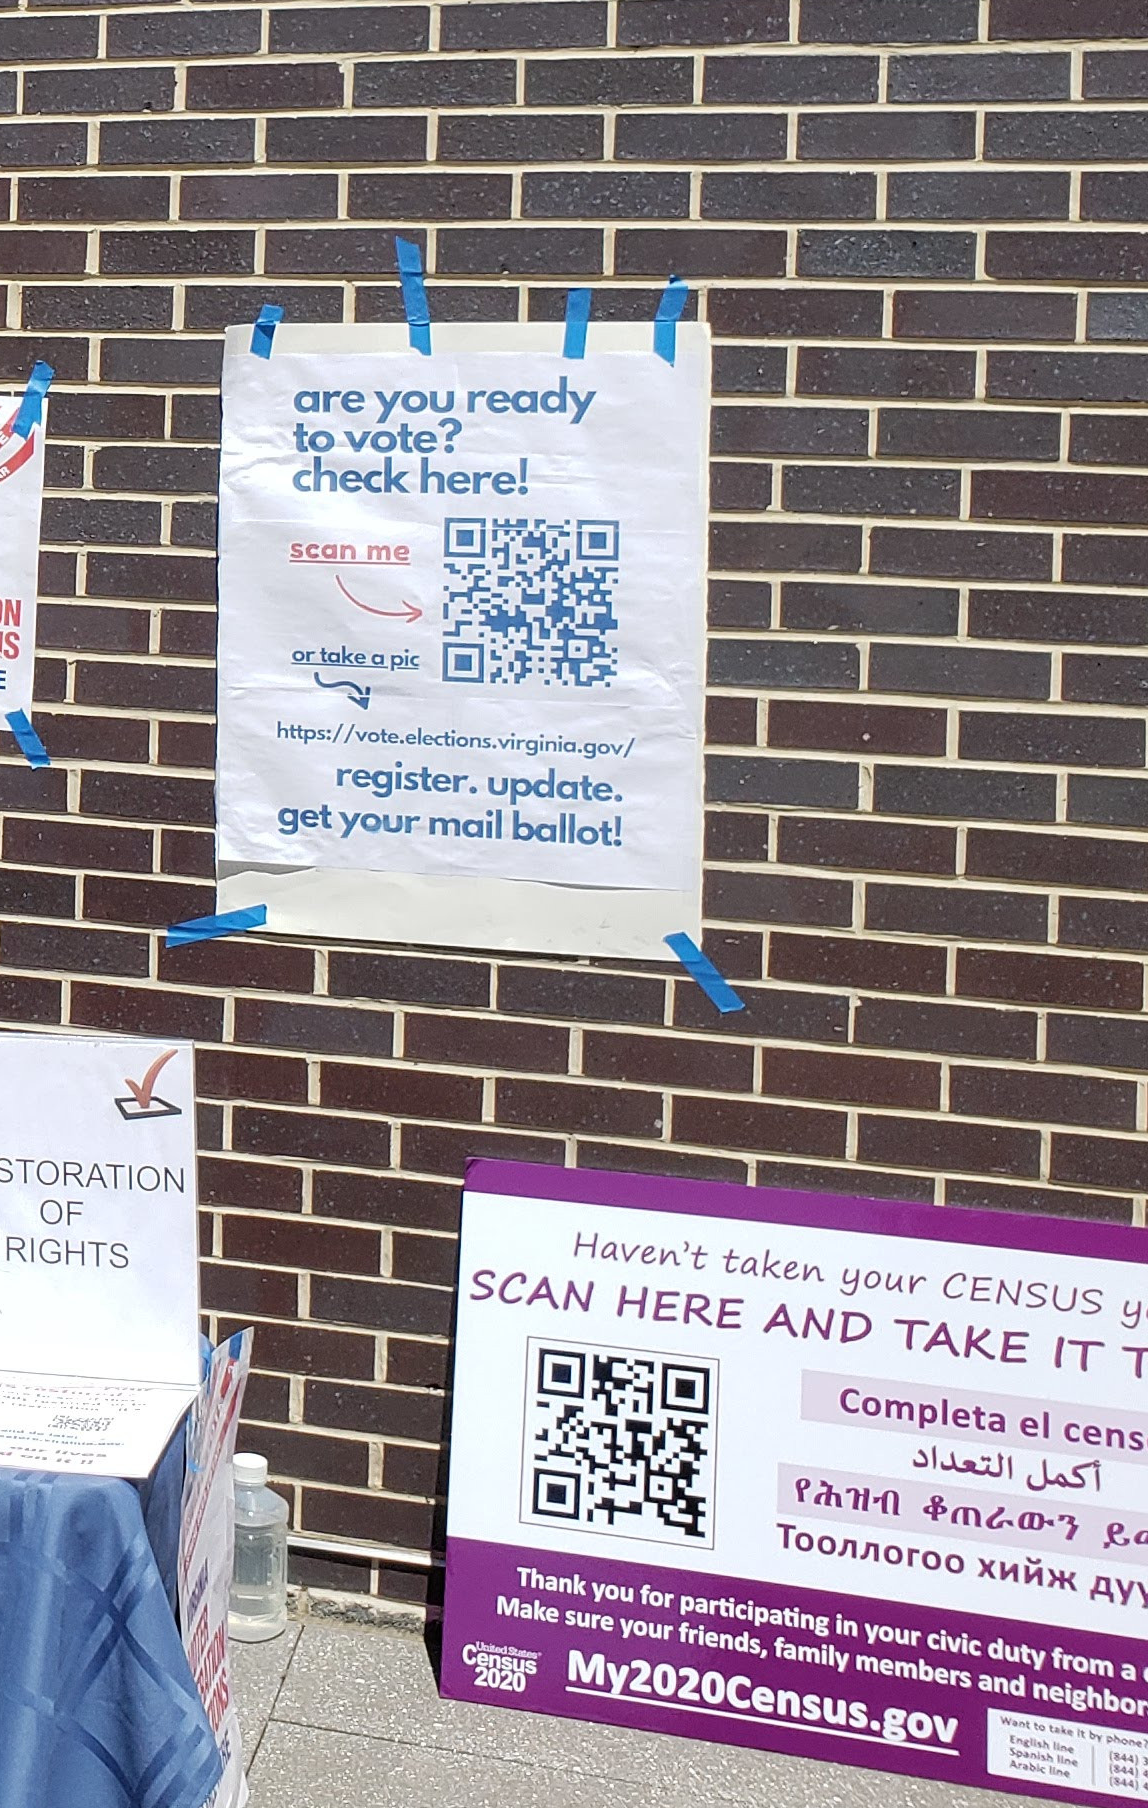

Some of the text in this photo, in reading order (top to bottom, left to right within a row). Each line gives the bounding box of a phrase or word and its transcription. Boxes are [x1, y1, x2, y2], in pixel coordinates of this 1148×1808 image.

[293, 375, 597, 425] are you ready
[293, 417, 463, 454] to vote?
[292, 455, 528, 496] check here!
[290, 541, 410, 562] scan me
[291, 645, 420, 671] or take a pic
[277, 721, 635, 759] https://vote.elections.virginia.gov/
[336, 761, 623, 805] register. update.
[277, 804, 622, 847] get your mail ballot!
[40, 1199, 84, 1226] OF
[6, 1236, 129, 1269] RIGHTS
[722, 1249, 824, 1282] taken
[839, 1267, 927, 1296] your
[943, 1272, 1102, 1315] CENSUS
[469, 1269, 594, 1312] SCAN
[617, 1285, 744, 1329] HERE
[763, 1303, 872, 1343] AND
[893, 1318, 1030, 1364] TAKE
[1054, 1336, 1105, 1372] IT
[839, 1387, 1148, 1452] Completa el cens
[912, 1445, 1102, 1492] أكمل التعداد
[776, 1523, 964, 1574] Тооллогоо
[977, 1557, 1077, 1592] хийж
[517, 1566, 586, 1595] Thank
[592, 1582, 634, 1603] you
[640, 1584, 674, 1608] for
[680, 1594, 829, 1637] participating
[835, 1614, 857, 1637] in
[865, 1622, 921, 1646] your
[927, 1630, 981, 1657] civic
[988, 1638, 1046, 1671] duty
[1052, 1647, 1114, 1678] from
[1121, 1662, 1137, 1681] a
[462, 1644, 537, 1675] Census
[476, 1641, 507, 1654] United
[496, 1595, 1148, 1716] Make sure your friends, family members and neighbor
[474, 1666, 526, 1692] 2020
[568, 1650, 958, 1743] My2020Census.gov
[1000, 1716, 1030, 1729] Want
[1034, 1722, 1045, 1732] to
[1049, 1724, 1074, 1737] take
[1077, 1728, 1086, 1739] it
[1089, 1731, 1102, 1743] by
[1009, 1748, 1053, 1763] Spanish
[1057, 1754, 1078, 1767] line
[1109, 1763, 1139, 1778] (844)
[1010, 1735, 1139, 1766] English line (844)
[1010, 1760, 1139, 1791] Arabic line (844)
